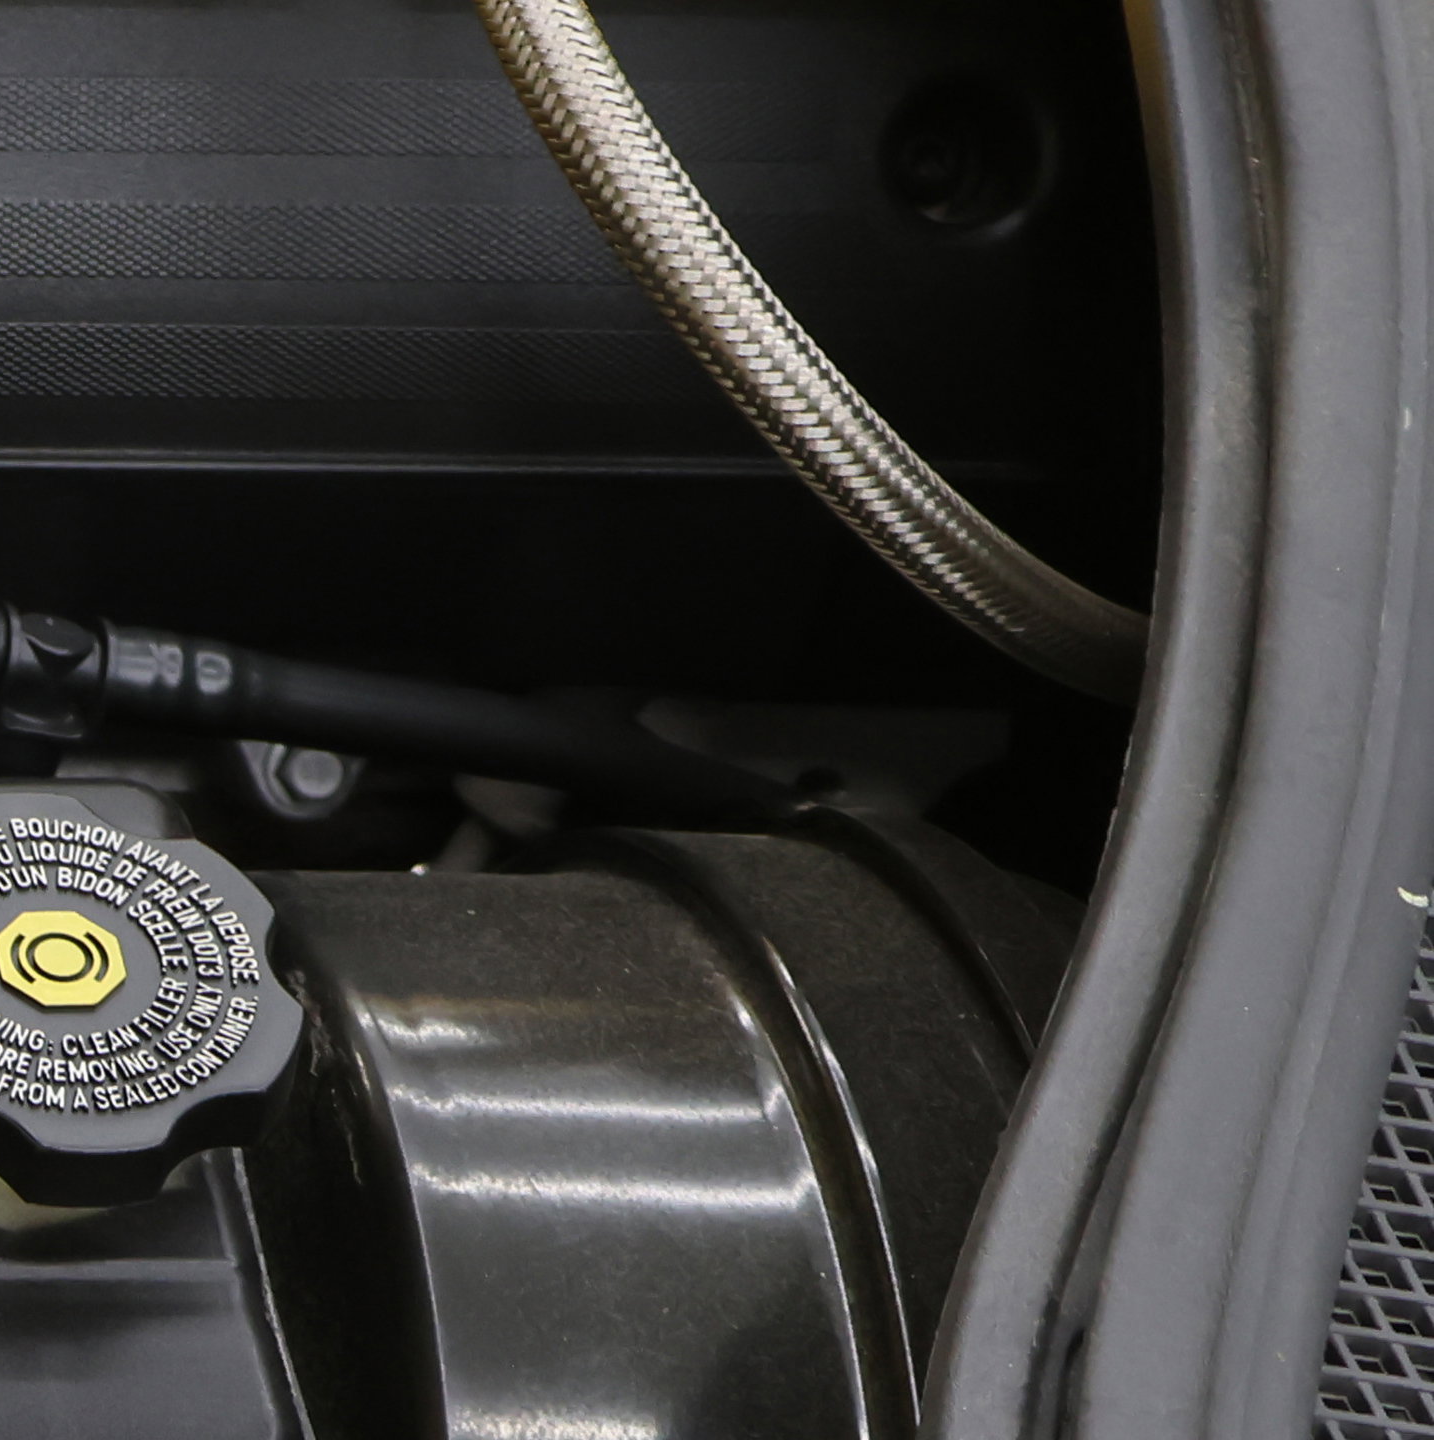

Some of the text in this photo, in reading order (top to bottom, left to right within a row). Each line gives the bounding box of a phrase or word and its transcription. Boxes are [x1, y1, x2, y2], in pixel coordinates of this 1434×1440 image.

[10, 817, 125, 852] BOUCHON
[125, 840, 200, 887] AVANT
[189, 883, 224, 912] LA
[211, 911, 260, 986] DEPOSE.
[16, 842, 112, 872] LIQUIDE
[113, 860, 148, 887] DE
[143, 879, 205, 929] FREIN
[187, 930, 225, 978] DOT3
[57, 866, 131, 906] BIDON
[127, 900, 189, 973] SCELLE.
[37, 1049, 166, 1083] REMOVING.
[155, 1023, 202, 1060] USE
[187, 982, 224, 1029] ONLY
[61, 1024, 140, 1056] CLEAN
[132, 976, 189, 1038] FILLER
[73, 1087, 89, 1109] A
[92, 1072, 181, 1111] SEALED
[174, 995, 260, 1086] CONTAINER.
